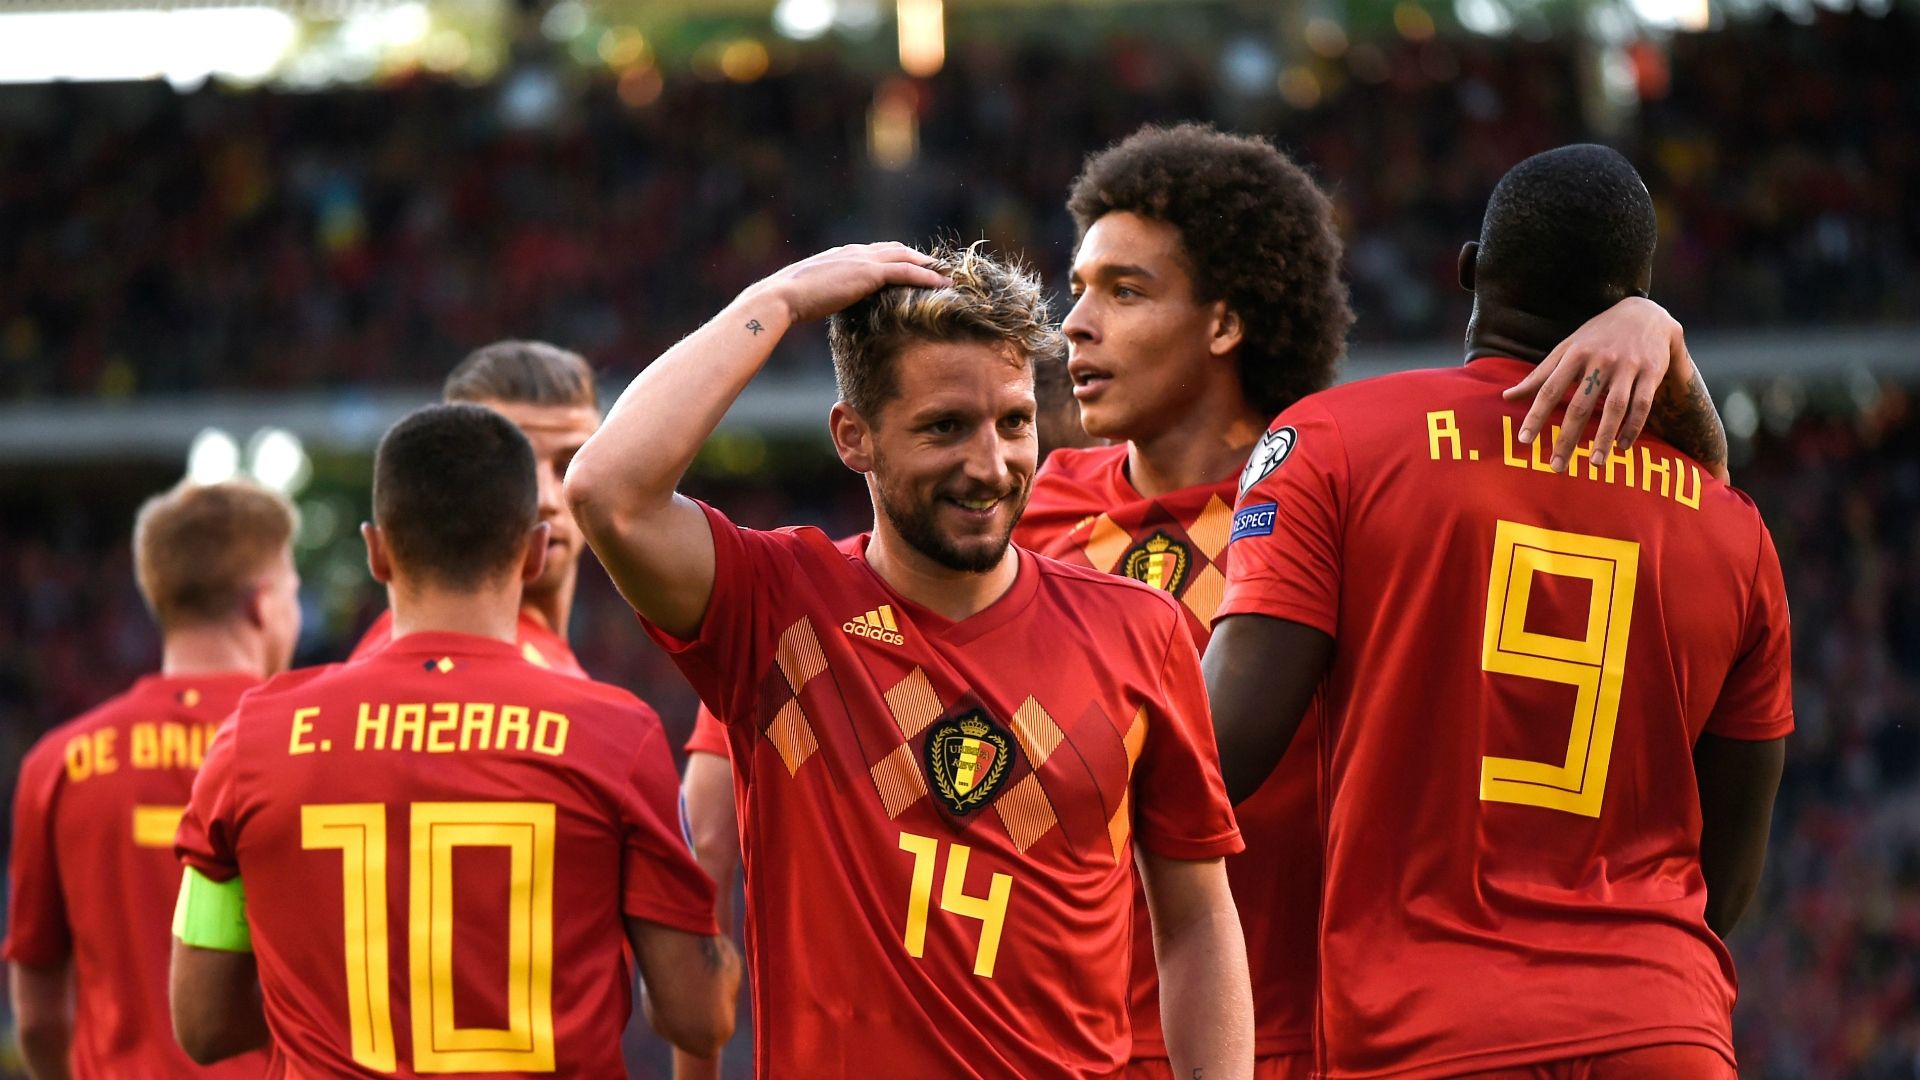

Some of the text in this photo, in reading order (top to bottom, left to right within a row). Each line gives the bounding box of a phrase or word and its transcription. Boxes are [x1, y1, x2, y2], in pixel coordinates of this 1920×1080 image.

[1426, 409, 1479, 461] R.
[842, 621, 904, 646] adidas
[1479, 519, 1640, 818] 9
[65, 720, 219, 783] DE BRU
[289, 702, 569, 756] E. HAZARD
[898, 831, 1013, 978] 14
[301, 802, 556, 1073] 10
